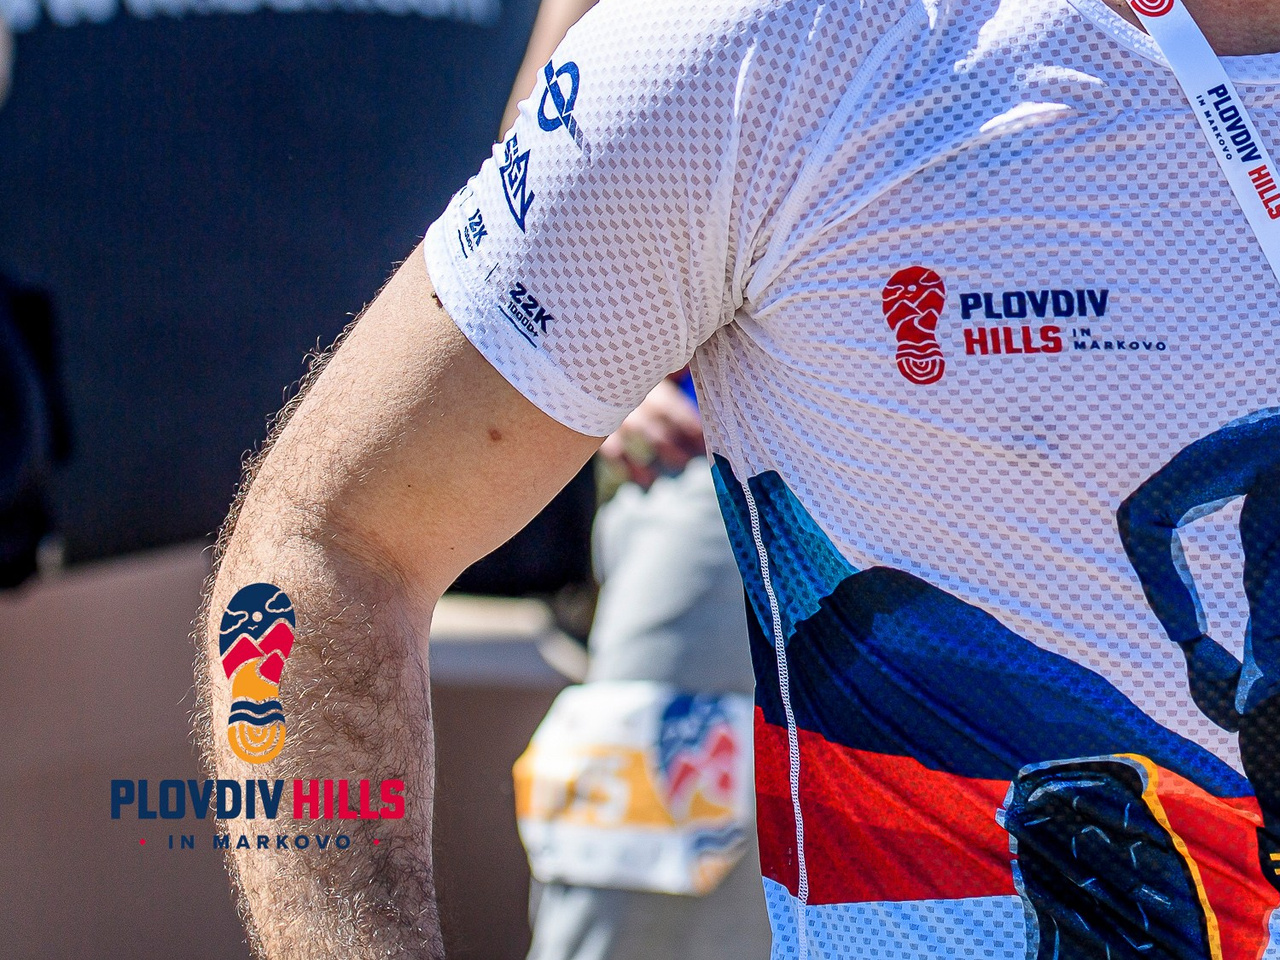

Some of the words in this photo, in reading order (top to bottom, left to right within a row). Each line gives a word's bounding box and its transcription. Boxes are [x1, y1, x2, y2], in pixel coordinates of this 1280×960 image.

[1196, 95, 1205, 107] IN
[1204, 110, 1233, 161] MARKOVO
[1207, 83, 1262, 163] PLOVDIV
[468, 208, 488, 247] 12K
[509, 282, 554, 334] 22K
[959, 289, 1109, 320] PLOVDIV
[963, 325, 1063, 356] HILLS
[1072, 328, 1091, 338] IN
[1073, 340, 1167, 352] MARKOVO
